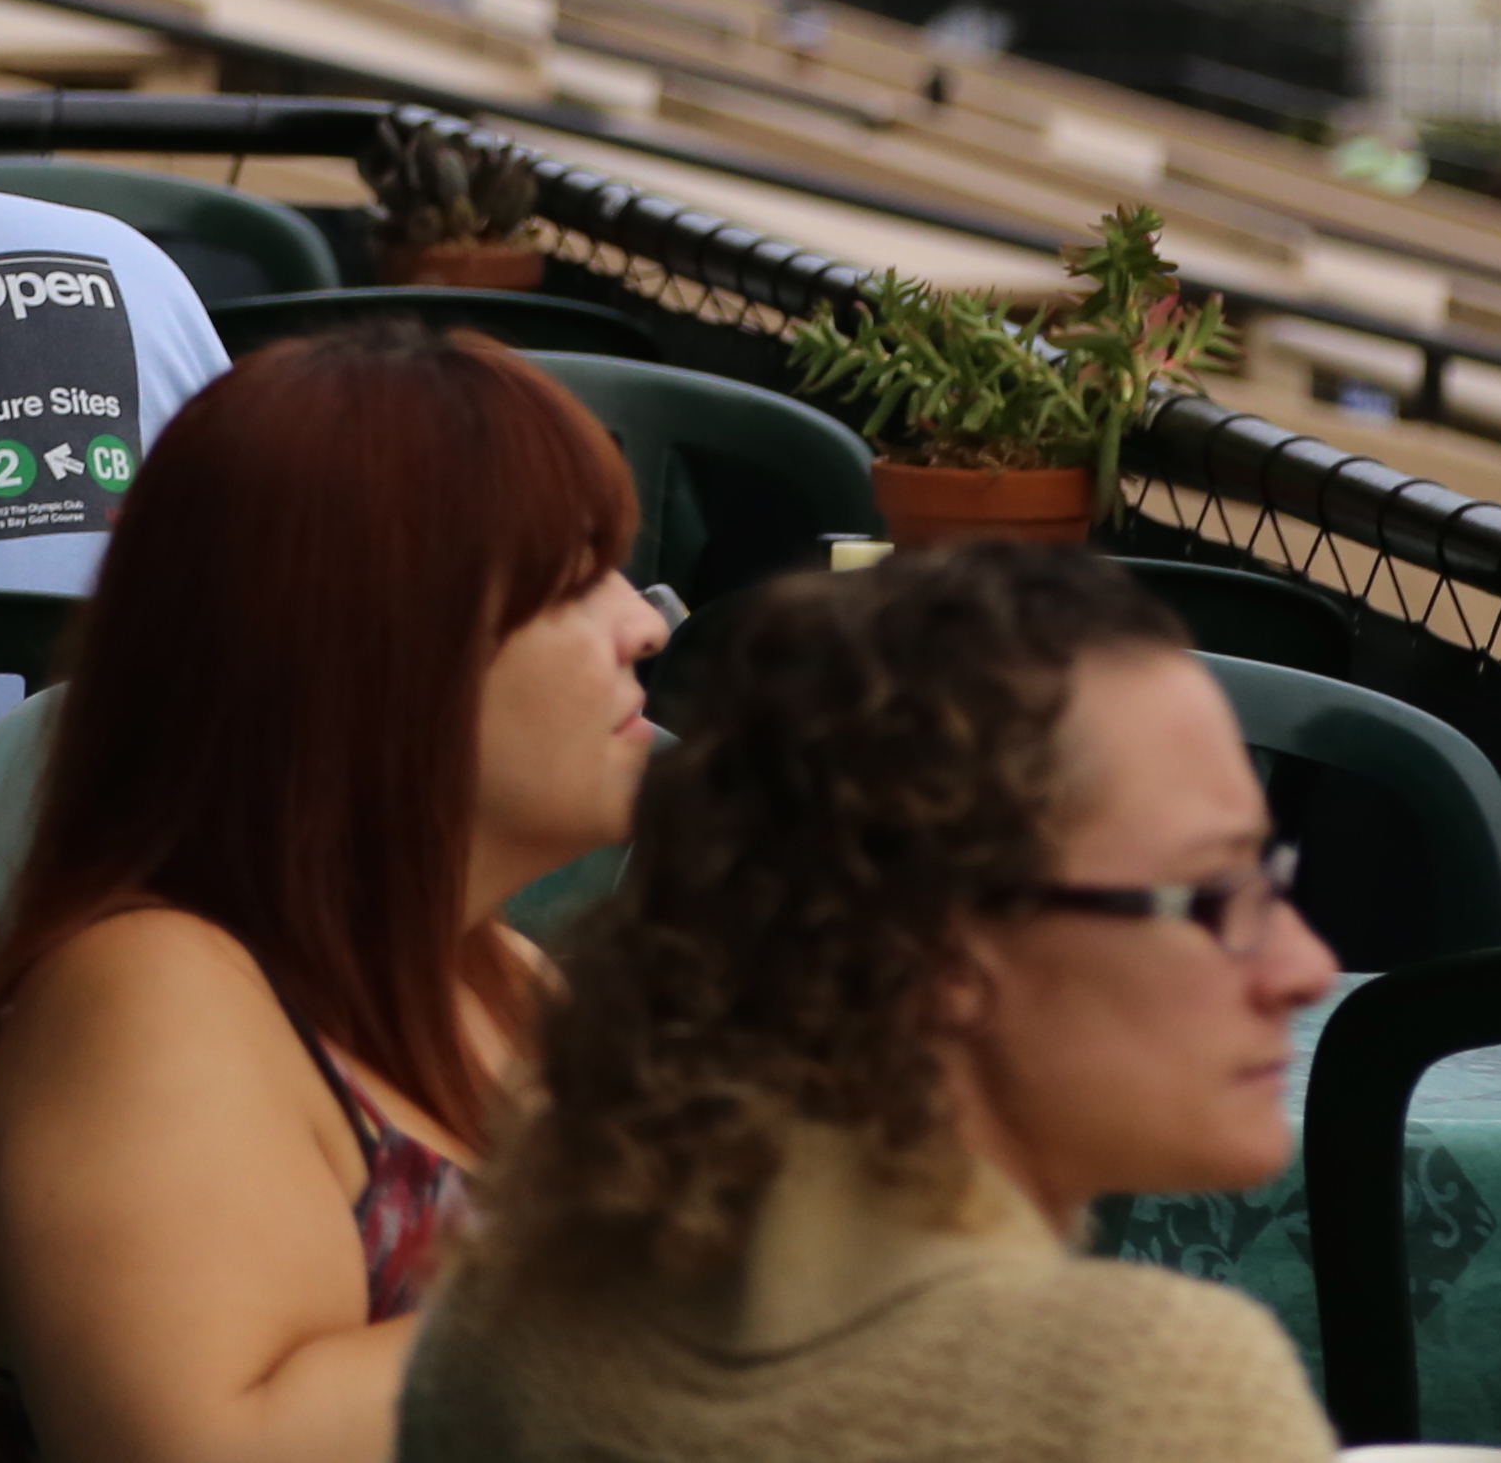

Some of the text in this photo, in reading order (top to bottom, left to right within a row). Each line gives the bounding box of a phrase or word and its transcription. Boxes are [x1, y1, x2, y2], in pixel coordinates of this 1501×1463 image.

[51, 386, 121, 418] Sites
[93, 446, 130, 481] CB
[10, 505, 27, 515] The
[27, 501, 63, 514] Olympic
[63, 500, 83, 510] Club
[8, 516, 27, 528] Bay
[28, 513, 49, 525] Golf
[51, 512, 85, 523] Course
